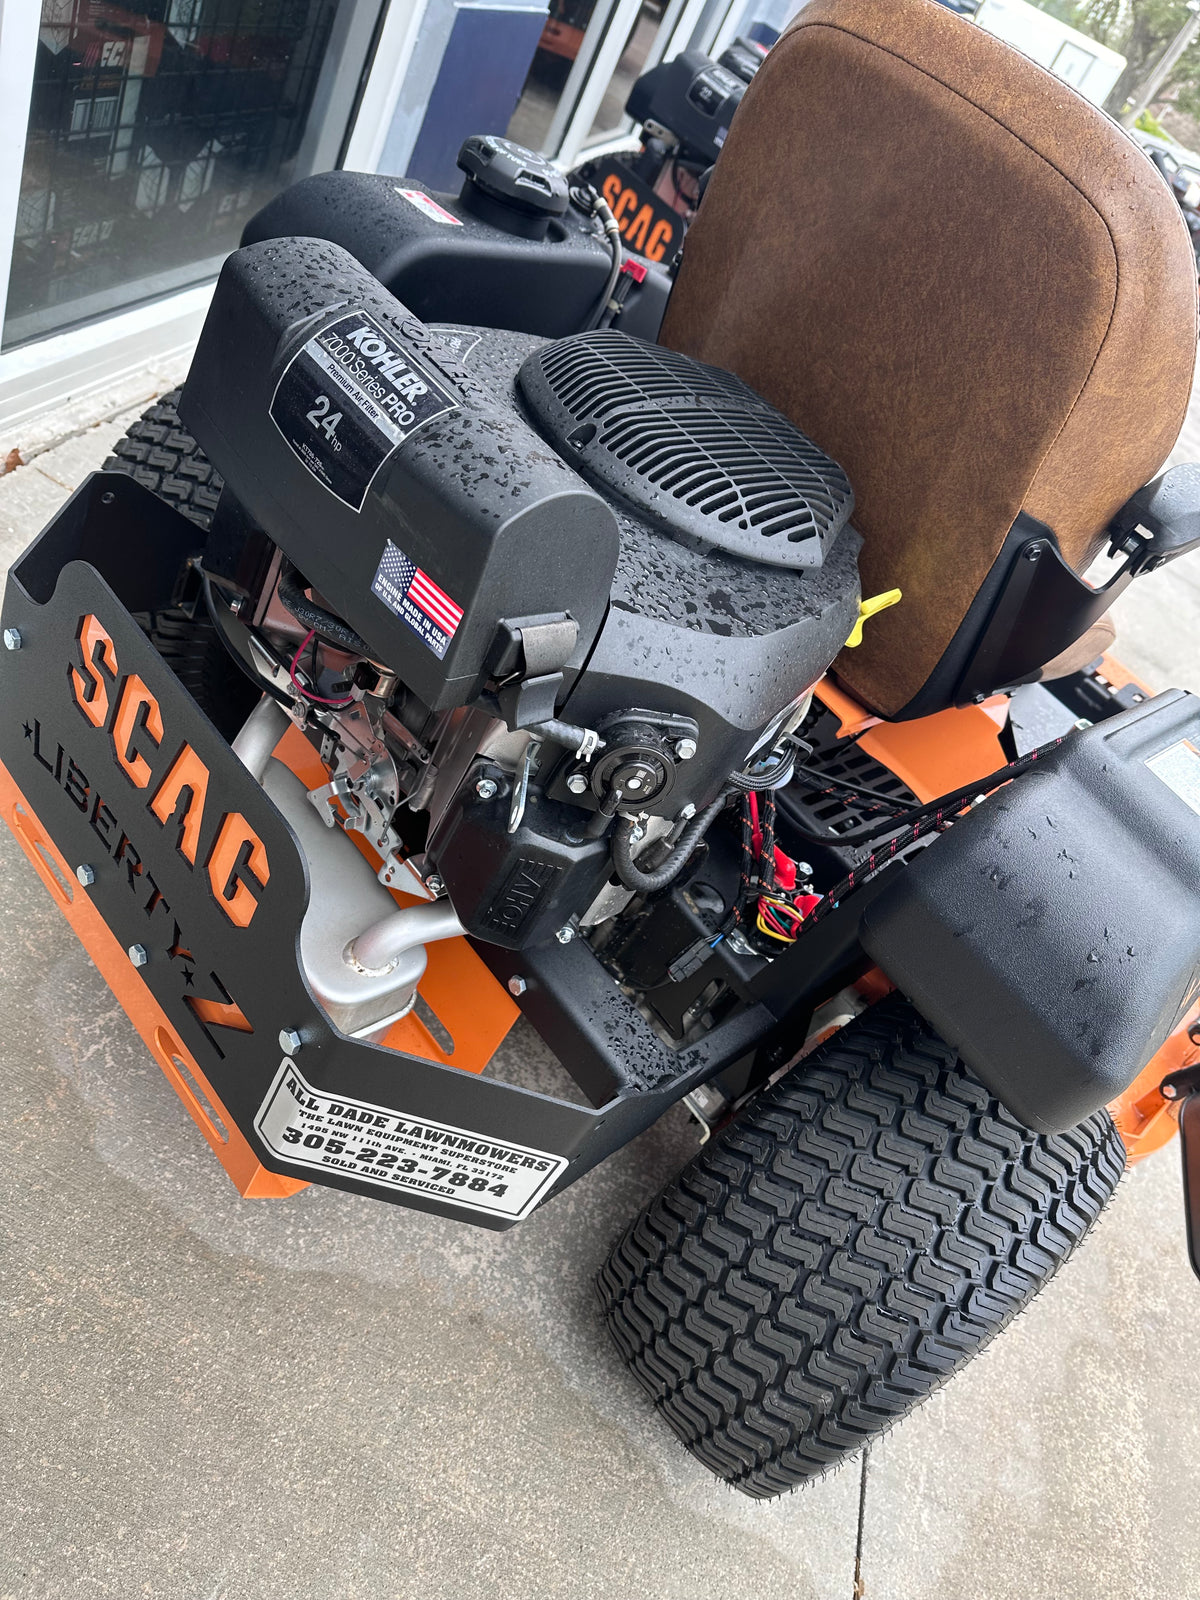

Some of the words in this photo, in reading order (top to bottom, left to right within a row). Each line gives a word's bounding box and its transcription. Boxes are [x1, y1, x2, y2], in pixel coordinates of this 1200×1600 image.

[602, 174, 673, 262] SCAG
[327, 364, 354, 393] Premium
[352, 391, 364, 404] Air
[361, 401, 379, 419] Filter
[346, 326, 428, 404] KOHLER
[380, 393, 415, 425] PRO
[375, 583, 383, 593] OF
[382, 590, 392, 603] U.S.
[393, 601, 405, 614] AND
[404, 612, 424, 636] GLOBAL
[424, 634, 444, 653] PARTS
[378, 574, 402, 600] ENGINE
[402, 598, 422, 622] MADE
[423, 616, 432, 631] IN
[431, 624, 447, 645] USA
[67, 614, 271, 928] SCAG
[33, 719, 196, 965] LIBERTY
[503, 872, 541, 919] OHV
[286, 1077, 320, 1111] ALL
[327, 1103, 390, 1129] DADE
[394, 1121, 551, 1172] LAWNMOWERS
[299, 1110, 325, 1122] THE
[327, 1118, 364, 1132] LAWN
[366, 1128, 439, 1152] EQUIPMENT
[440, 1148, 518, 1174] SUPERSTORE
[301, 1123, 329, 1134] 1495
[331, 1130, 349, 1139] NW
[352, 1136, 382, 1148] 111th
[385, 1143, 407, 1155] AVE.
[456, 1163, 469, 1171] FL
[471, 1167, 505, 1181] 33172
[282, 1126, 509, 1198] 305-223-7884
[322, 1155, 358, 1170] SOLD
[360, 1165, 388, 1178] AND
[391, 1173, 456, 1195] SERVICED
